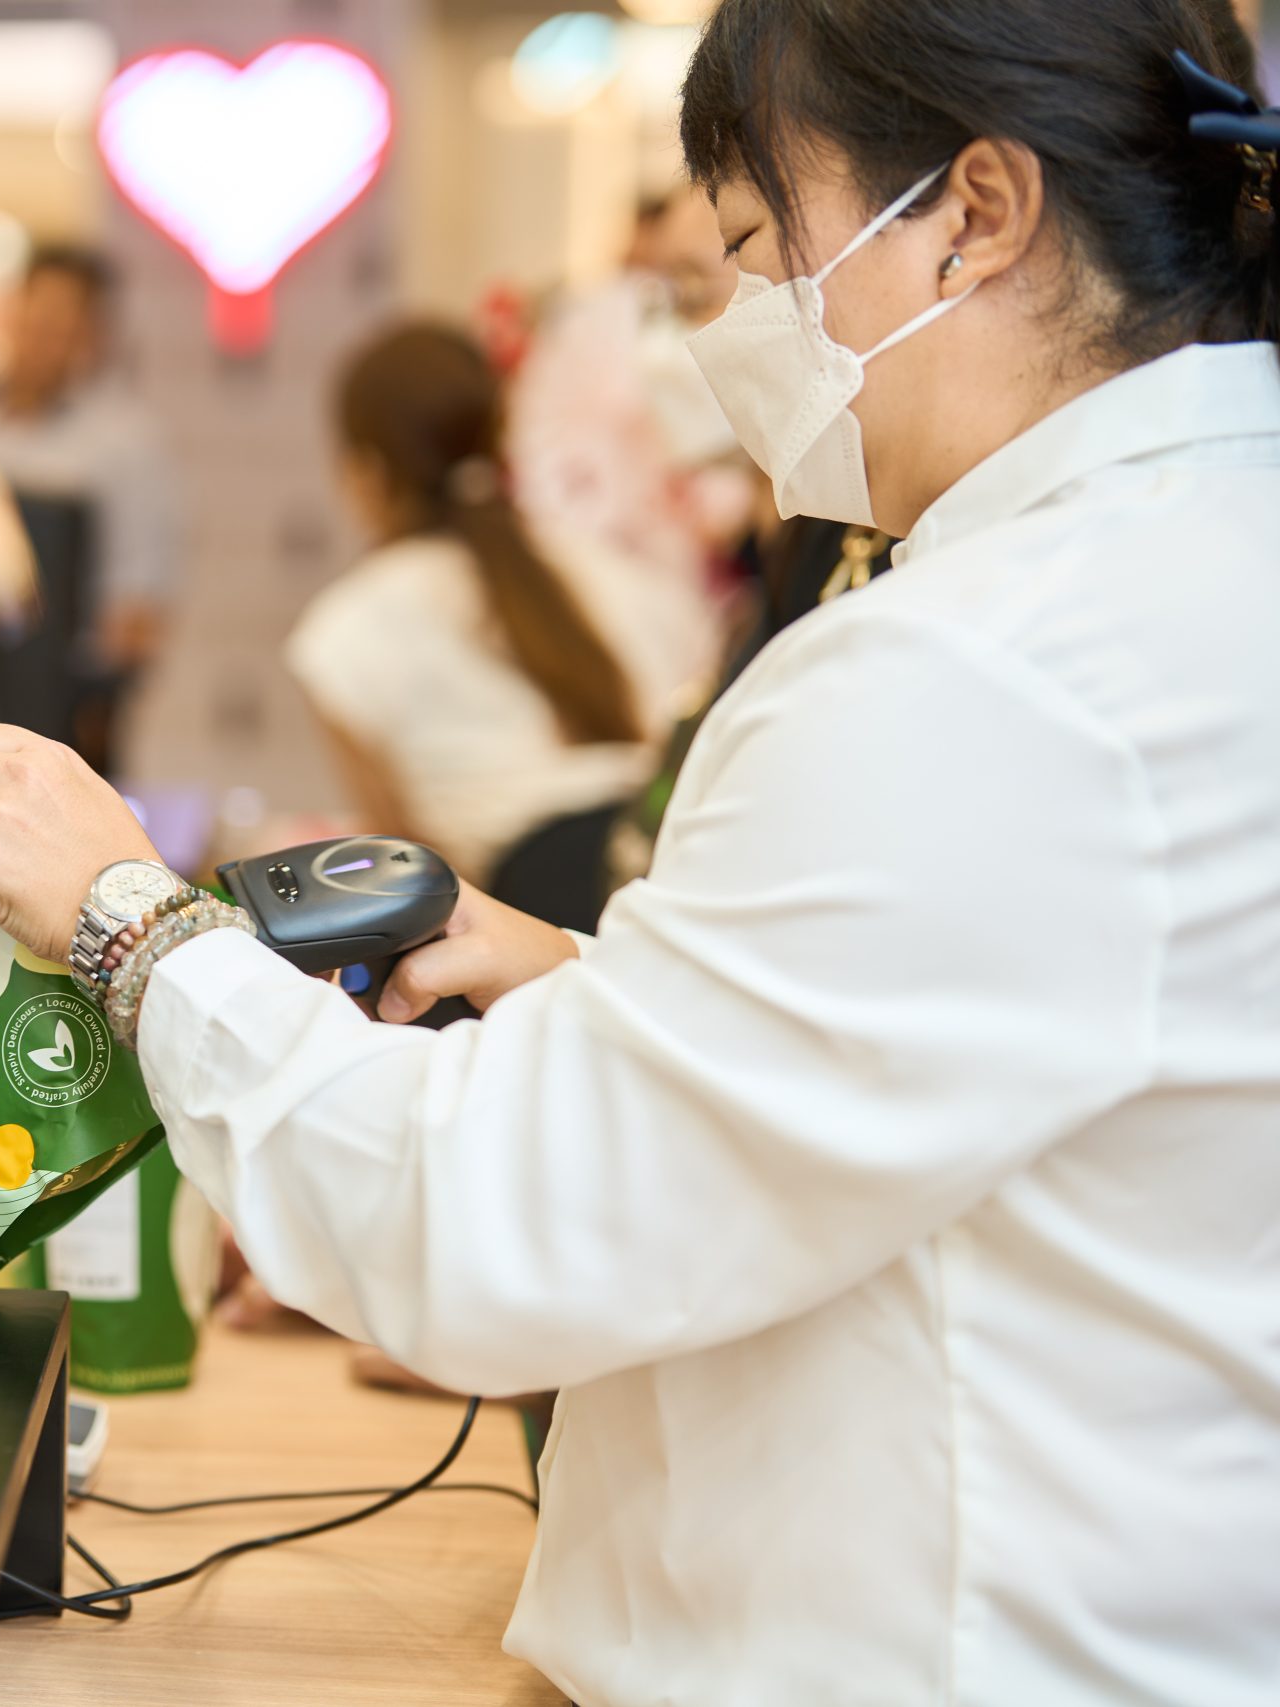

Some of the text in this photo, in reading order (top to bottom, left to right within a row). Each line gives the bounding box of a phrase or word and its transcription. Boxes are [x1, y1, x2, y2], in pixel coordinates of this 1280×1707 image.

[6, 1005, 37, 1087] Simply Delicious
[46, 998, 106, 1051] Locally Owned
[30, 1061, 105, 1103] Carefully Crafted
